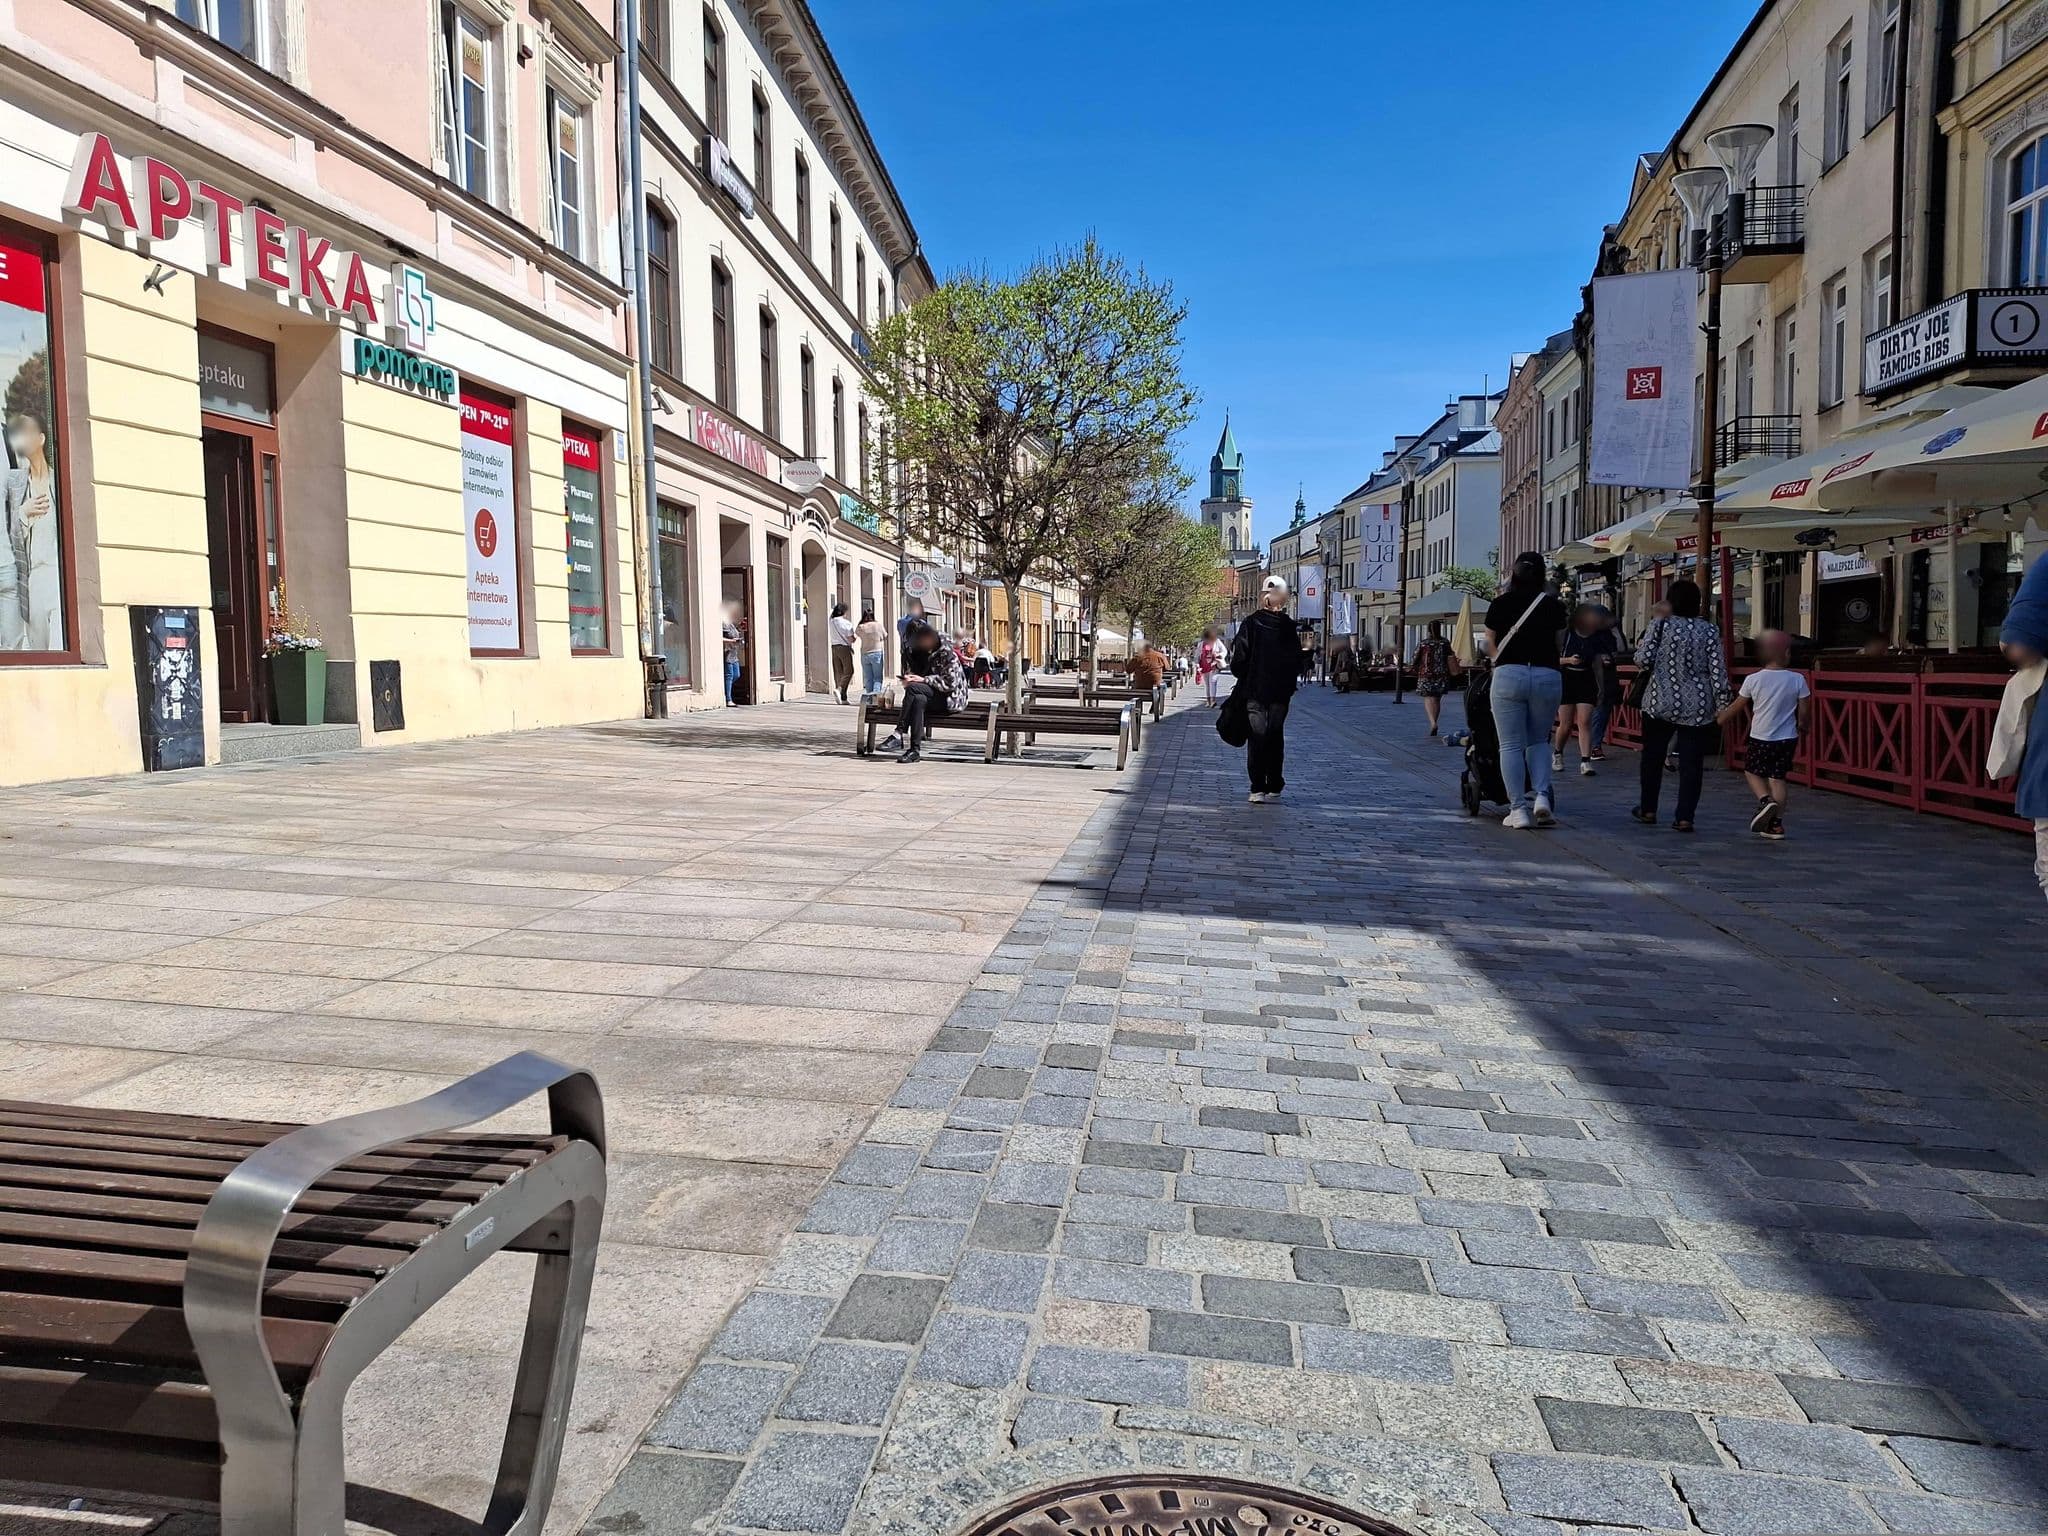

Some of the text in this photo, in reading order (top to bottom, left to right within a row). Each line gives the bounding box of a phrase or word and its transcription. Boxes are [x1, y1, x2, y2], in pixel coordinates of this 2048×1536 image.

[76, 133, 378, 324] APTEKA
[1880, 311, 1950, 360] DIRTY JOE
[355, 338, 455, 395] pomocna
[1879, 337, 1950, 381] FAMOUS RIBS
[199, 364, 245, 390] eptaku
[460, 403, 477, 421] PEN
[561, 436, 591, 459] APTEKA
[696, 406, 768, 477] ROSSMANN
[1775, 481, 1806, 497] PERŁA
[475, 570, 499, 586] Apteka
[466, 588, 508, 604] internetowa
[467, 616, 513, 627] ptekapomocna24.pl
